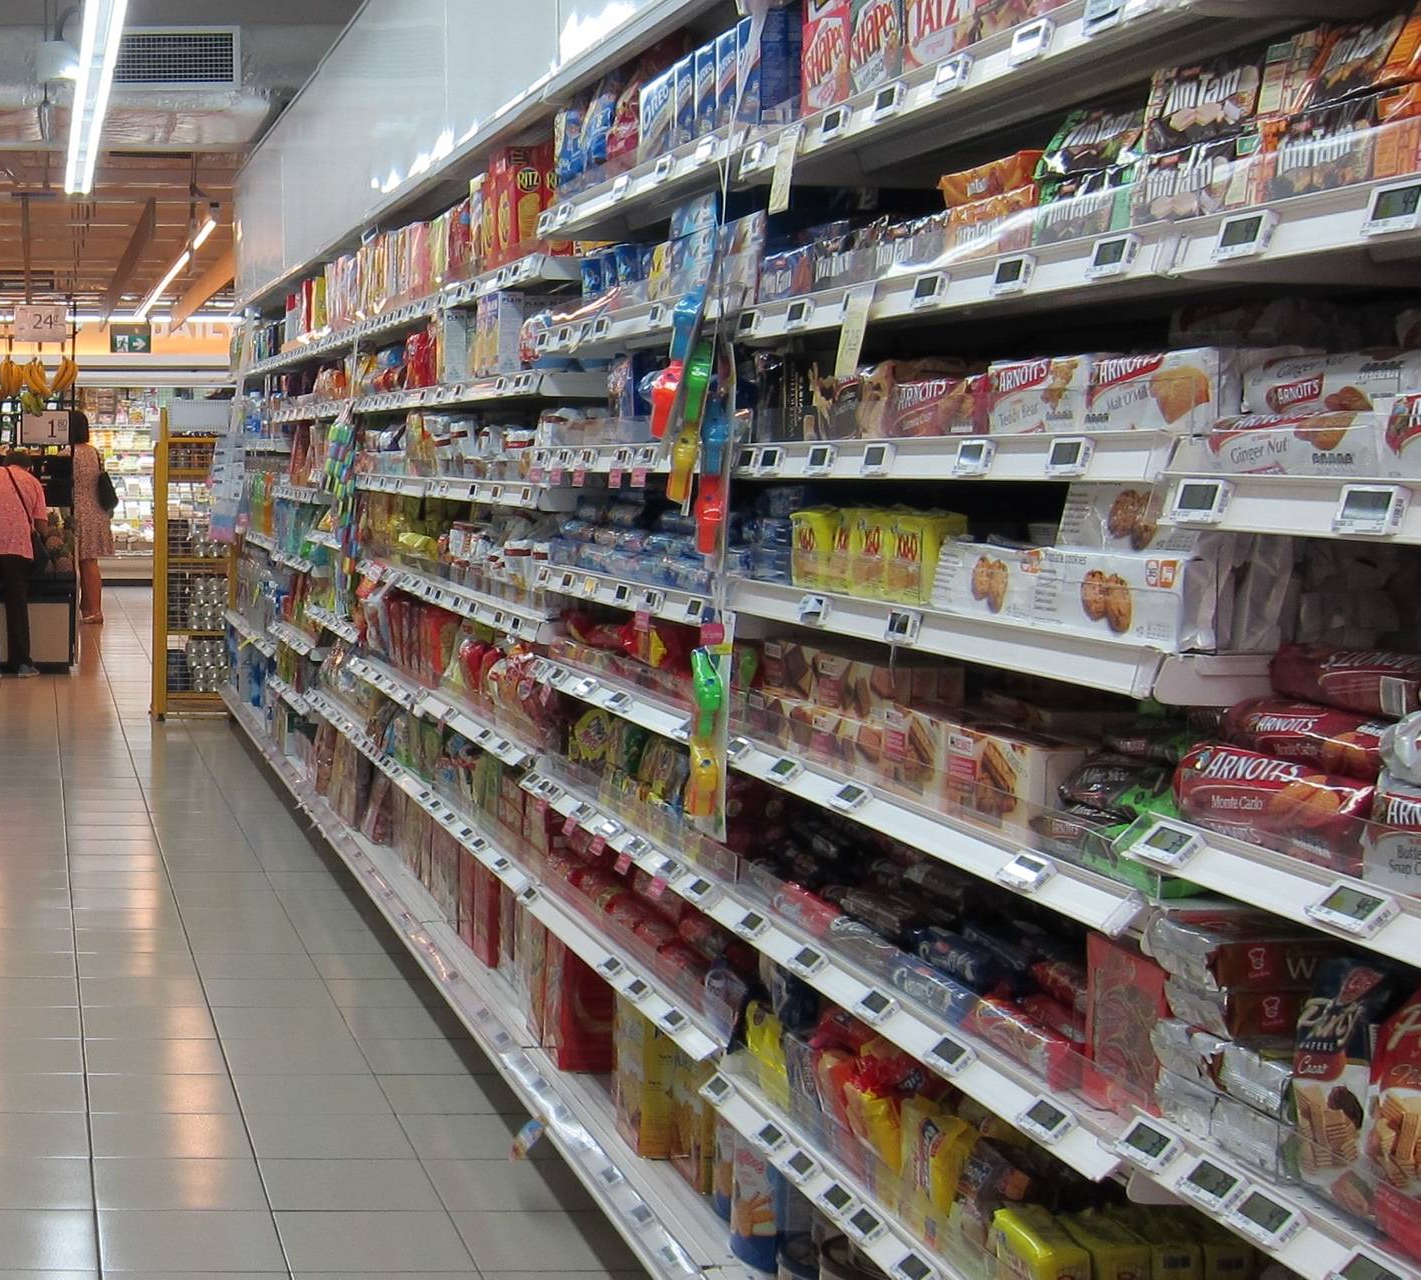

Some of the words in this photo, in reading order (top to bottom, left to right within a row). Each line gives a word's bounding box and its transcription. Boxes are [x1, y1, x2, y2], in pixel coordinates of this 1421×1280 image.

[642, 84, 669, 131] OREO
[517, 171, 539, 187] RITZ
[33, 313, 53, 329] 24
[998, 361, 1049, 392] ARNOTT'S
[1229, 443, 1264, 465] Ginger
[1267, 437, 1288, 453] Nut
[1202, 751, 1305, 783] ARNOTT'S
[1211, 795, 1238, 809] Monte
[1240, 797, 1263, 811] Carlo
[1396, 844, 1421, 860] Butte
